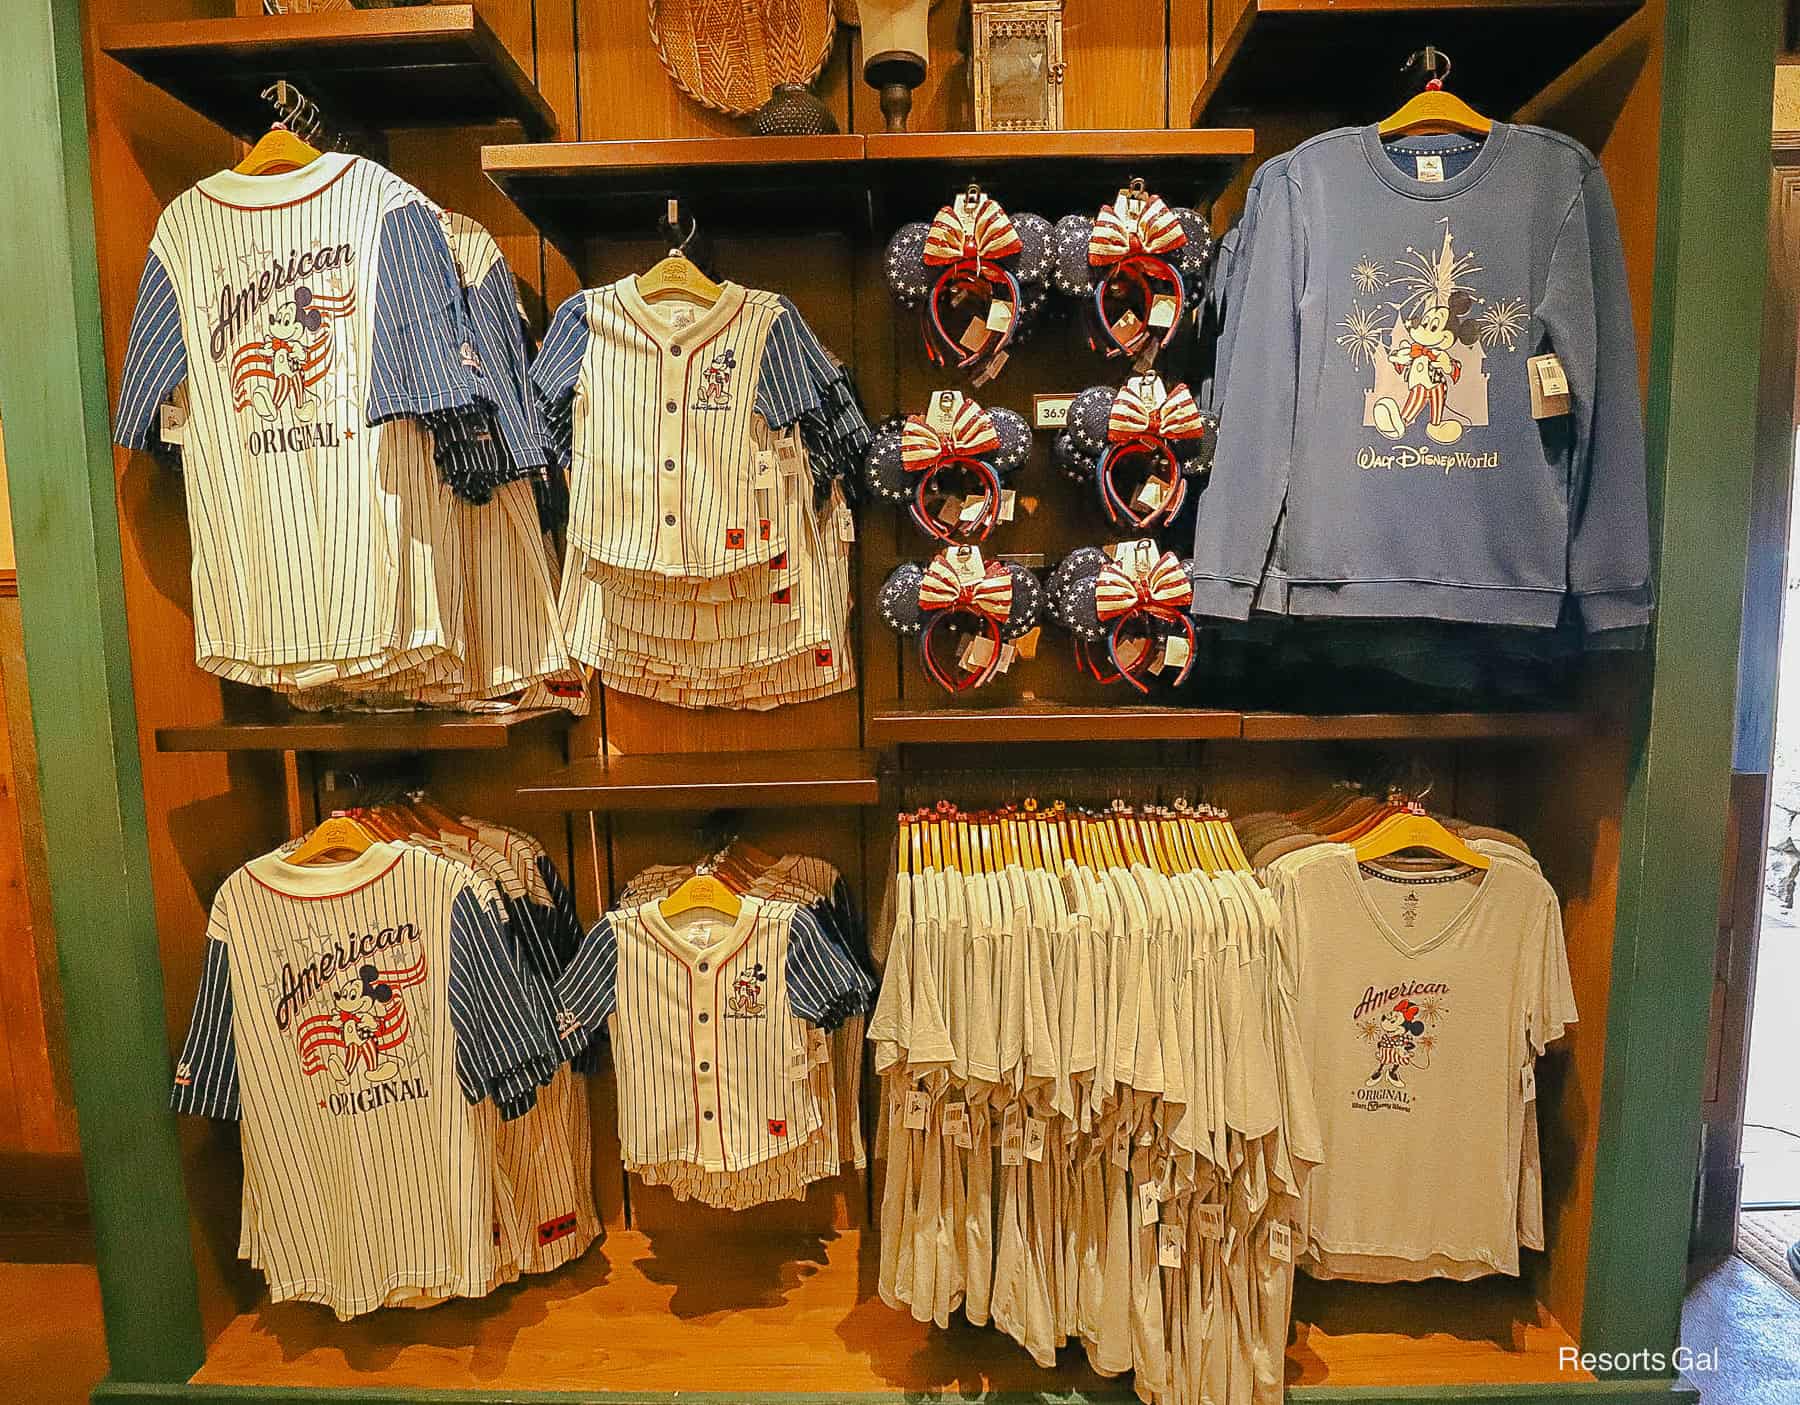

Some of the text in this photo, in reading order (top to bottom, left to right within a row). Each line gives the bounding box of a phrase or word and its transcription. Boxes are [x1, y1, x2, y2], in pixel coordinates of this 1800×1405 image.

[210, 243, 356, 362] American
[1043, 408, 1067, 418] 36.9
[249, 422, 340, 456] ORIGINAL
[1455, 451, 1498, 469] World
[276, 922, 422, 1032] American
[1353, 980, 1449, 1020] American
[329, 1078, 429, 1116] ORIGINAL
[1357, 1088, 1410, 1104] ORIGINAL
